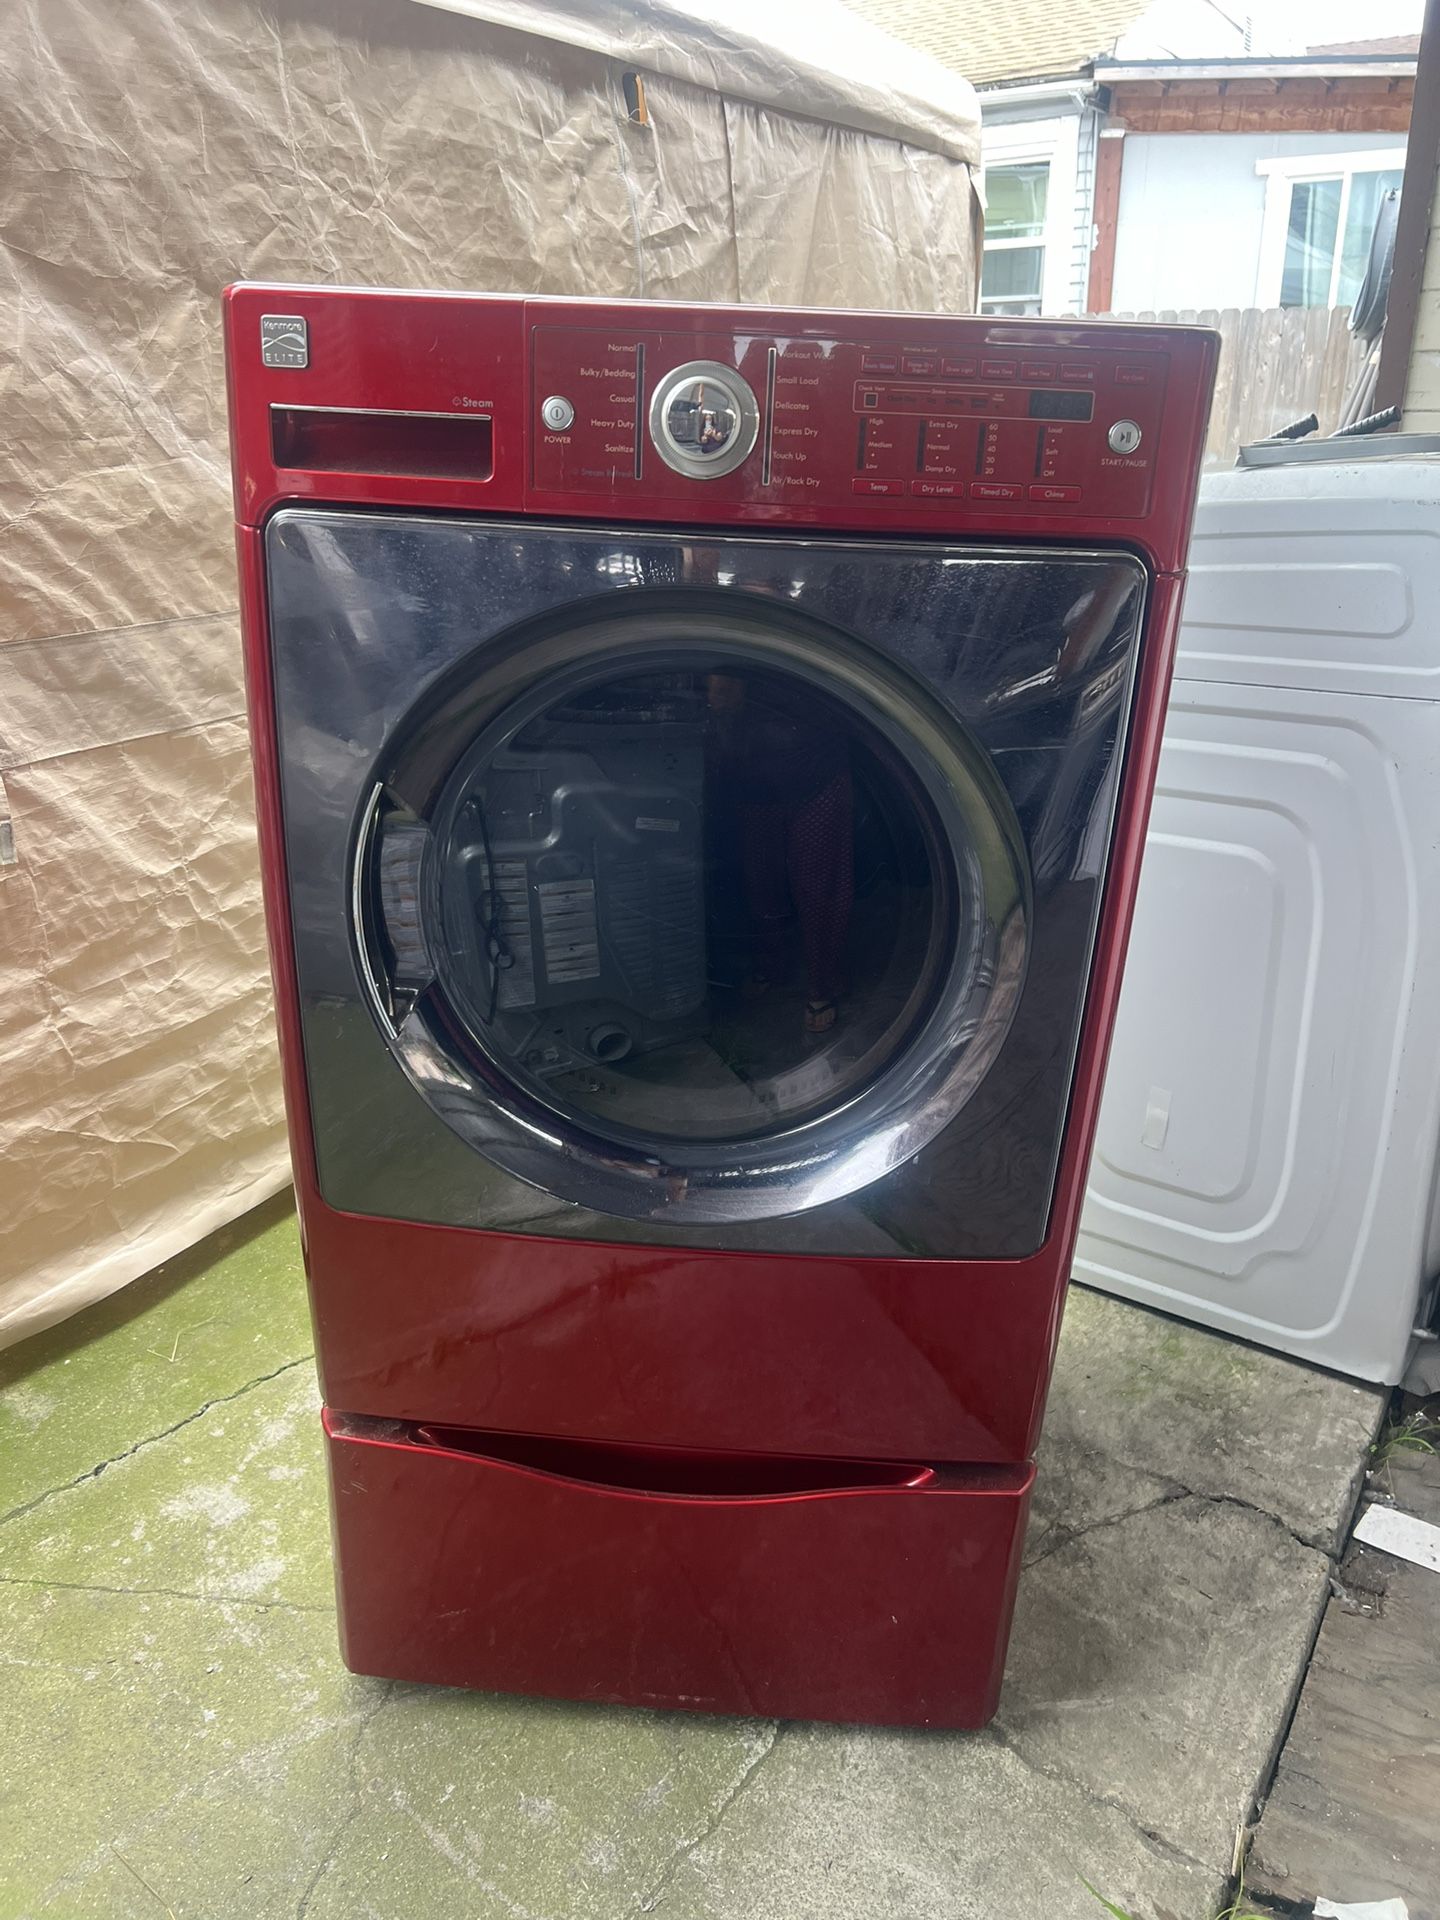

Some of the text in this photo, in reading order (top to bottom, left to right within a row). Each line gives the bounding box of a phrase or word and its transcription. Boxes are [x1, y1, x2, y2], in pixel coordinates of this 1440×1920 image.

[263, 320, 303, 331] Kenmore
[608, 343, 637, 352] Normal
[265, 352, 303, 363] ELITE
[580, 367, 636, 379] Bulky/Bedding
[776, 375, 819, 385] Small Load
[462, 397, 494, 408] Steam
[609, 394, 636, 403] Casual
[775, 401, 810, 411] Delicates
[590, 419, 635, 430] Heavy Duty
[869, 418, 884, 426] High
[929, 420, 959, 430] Extra Dry
[989, 423, 999, 431] 60
[774, 426, 818, 438] Express Dry
[544, 435, 571, 444] POWER
[604, 443, 634, 453] Sanitize
[987, 445, 996, 453] 40
[773, 451, 807, 462] Touch Up
[1101, 458, 1148, 468] START/PAUSE
[925, 465, 957, 474] Damp Dry
[985, 467, 994, 475] 20
[806, 478, 821, 488] Dry
[870, 483, 888, 492] Temp
[921, 485, 954, 494] Dry Level
[980, 487, 1014, 497] Timed Dry
[1044, 490, 1065, 498] Chime
